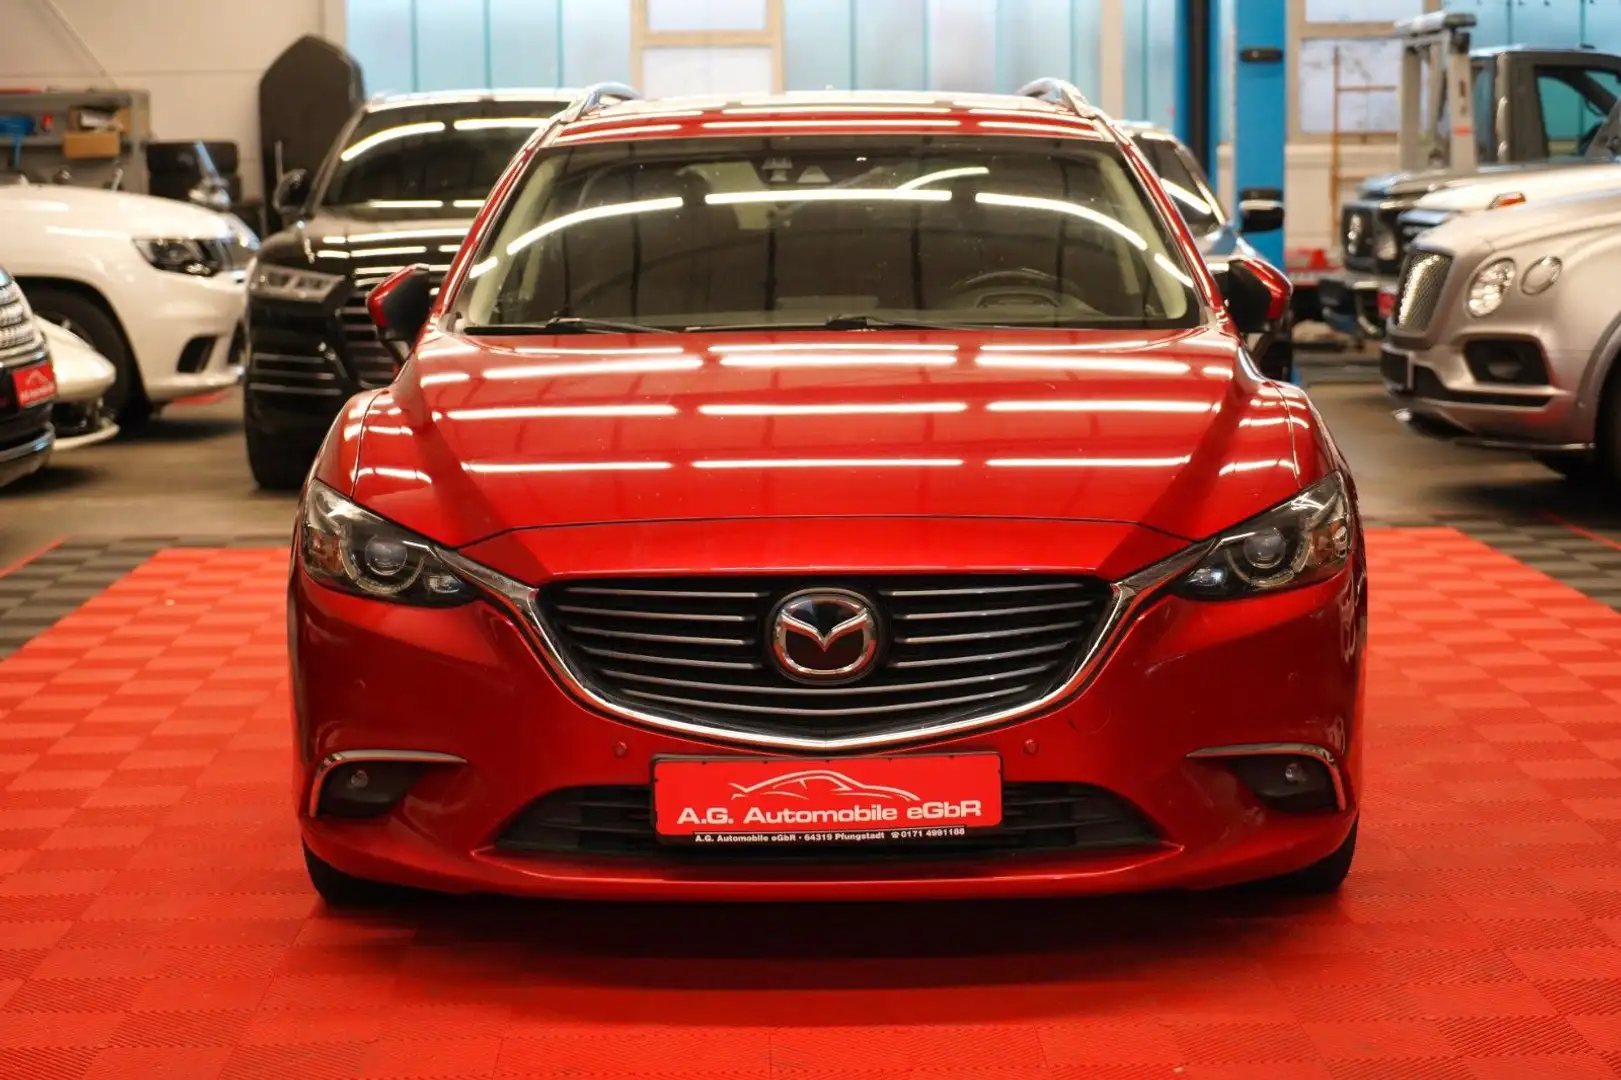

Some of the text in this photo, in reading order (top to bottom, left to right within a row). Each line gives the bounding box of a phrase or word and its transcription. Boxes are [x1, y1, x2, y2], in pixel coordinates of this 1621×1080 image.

[677, 800, 982, 825] A.G. Automobile eGbR
[695, 834, 715, 842] A.G.
[717, 833, 769, 842] Automobile
[771, 833, 796, 842] eGbR
[804, 832, 833, 841] 64319
[834, 831, 885, 841] Pfungstadt
[901, 830, 923, 838] 0171
